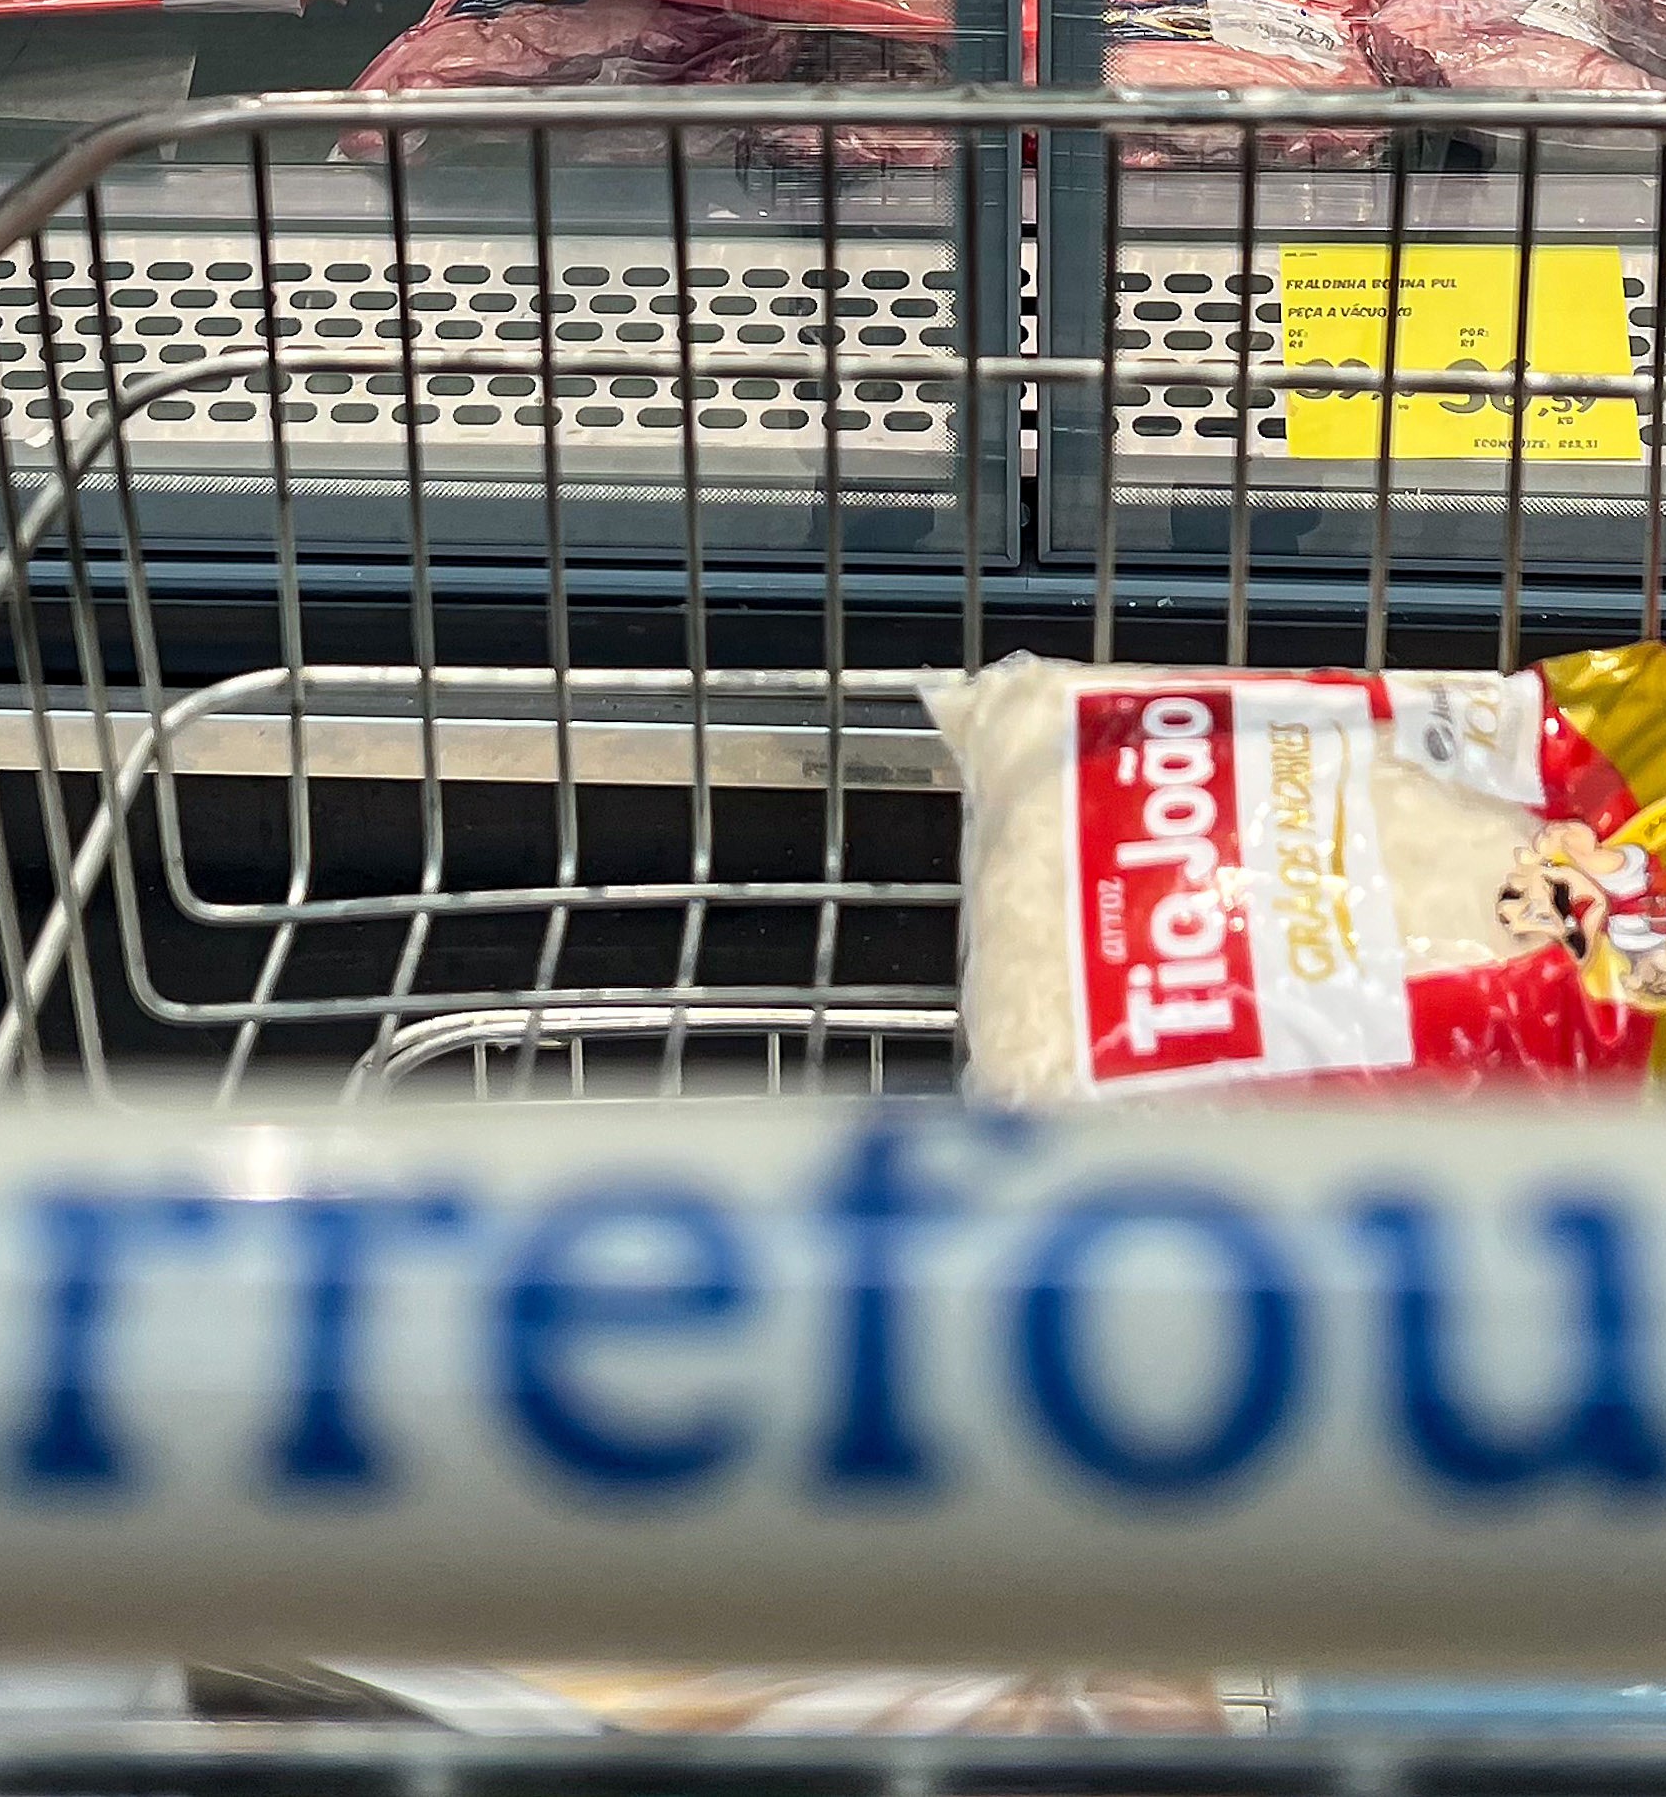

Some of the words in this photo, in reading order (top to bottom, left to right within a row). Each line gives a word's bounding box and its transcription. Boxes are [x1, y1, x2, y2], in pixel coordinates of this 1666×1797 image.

[1286, 278, 1368, 292] FRALDINHA
[1372, 278, 1426, 292] BOINA
[1430, 277, 1458, 291] PUL
[1288, 306, 1323, 322] PEÇA
[1325, 307, 1337, 320] A
[1341, 303, 1387, 320] VÁCUO
[1460, 328, 1489, 338] POR:
